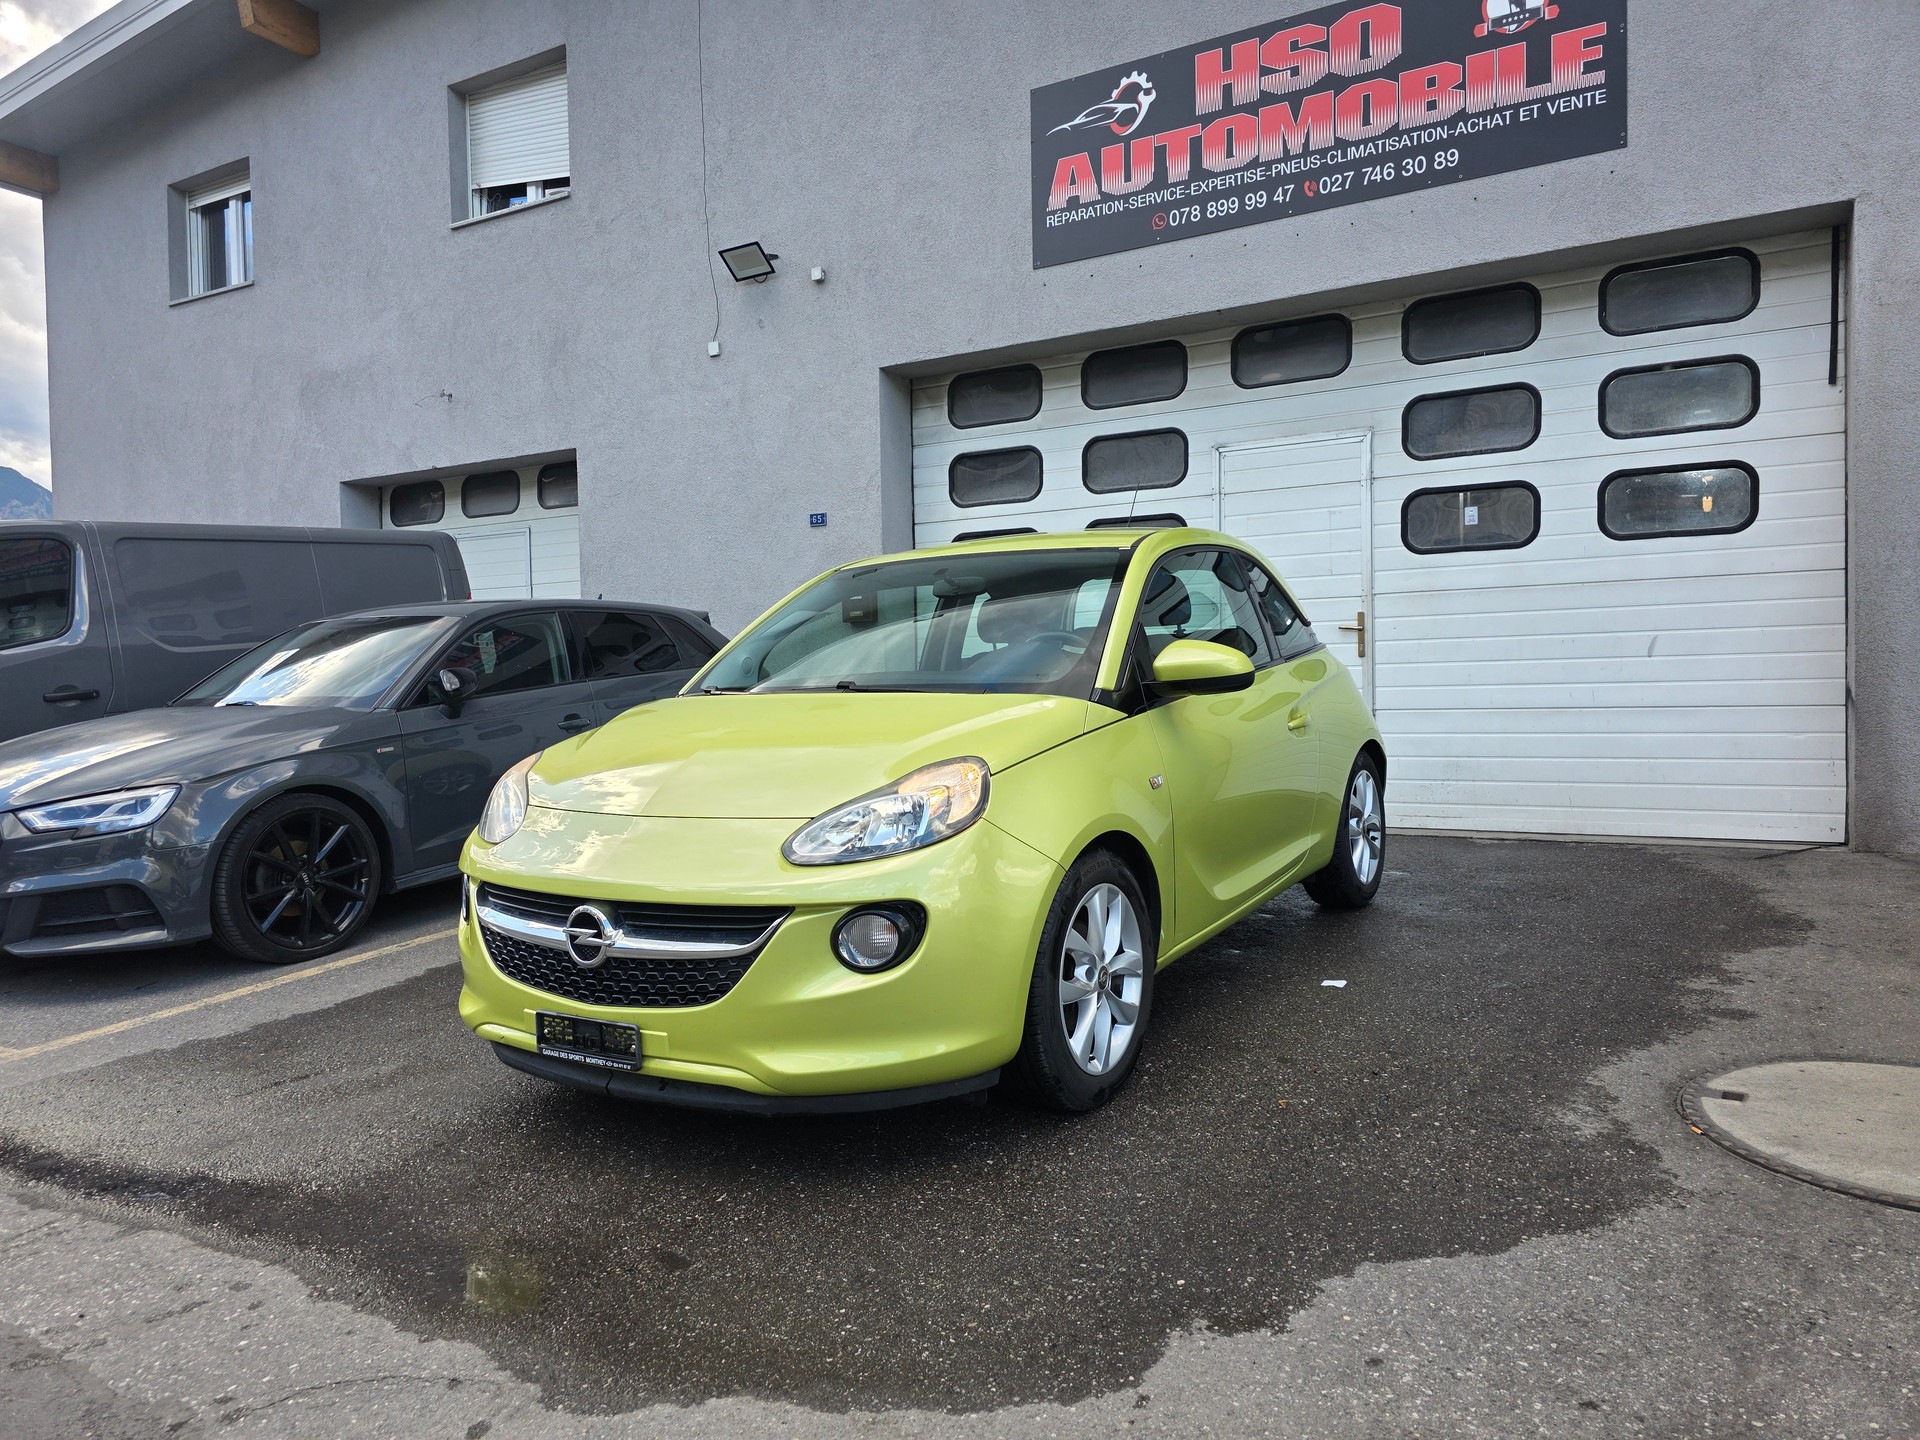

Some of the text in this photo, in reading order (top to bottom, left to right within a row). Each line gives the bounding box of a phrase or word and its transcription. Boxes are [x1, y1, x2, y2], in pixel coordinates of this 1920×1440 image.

[1195, 3, 1402, 115] HSO
[1046, 22, 1607, 212] AUTOMOBILE
[1046, 89, 1607, 228] RÉPARATION-SERVICE-EXPERTISE-PNEUS-CLIMATISATION-ACHAT ET VENTE
[1169, 149, 1459, 227] 078 899 99 47 027 746 30 89
[812, 515, 822, 523] 65
[542, 1048, 559, 1058] GARAGE
[560, 1051, 568, 1059] DES
[568, 1053, 585, 1062] SPORTS
